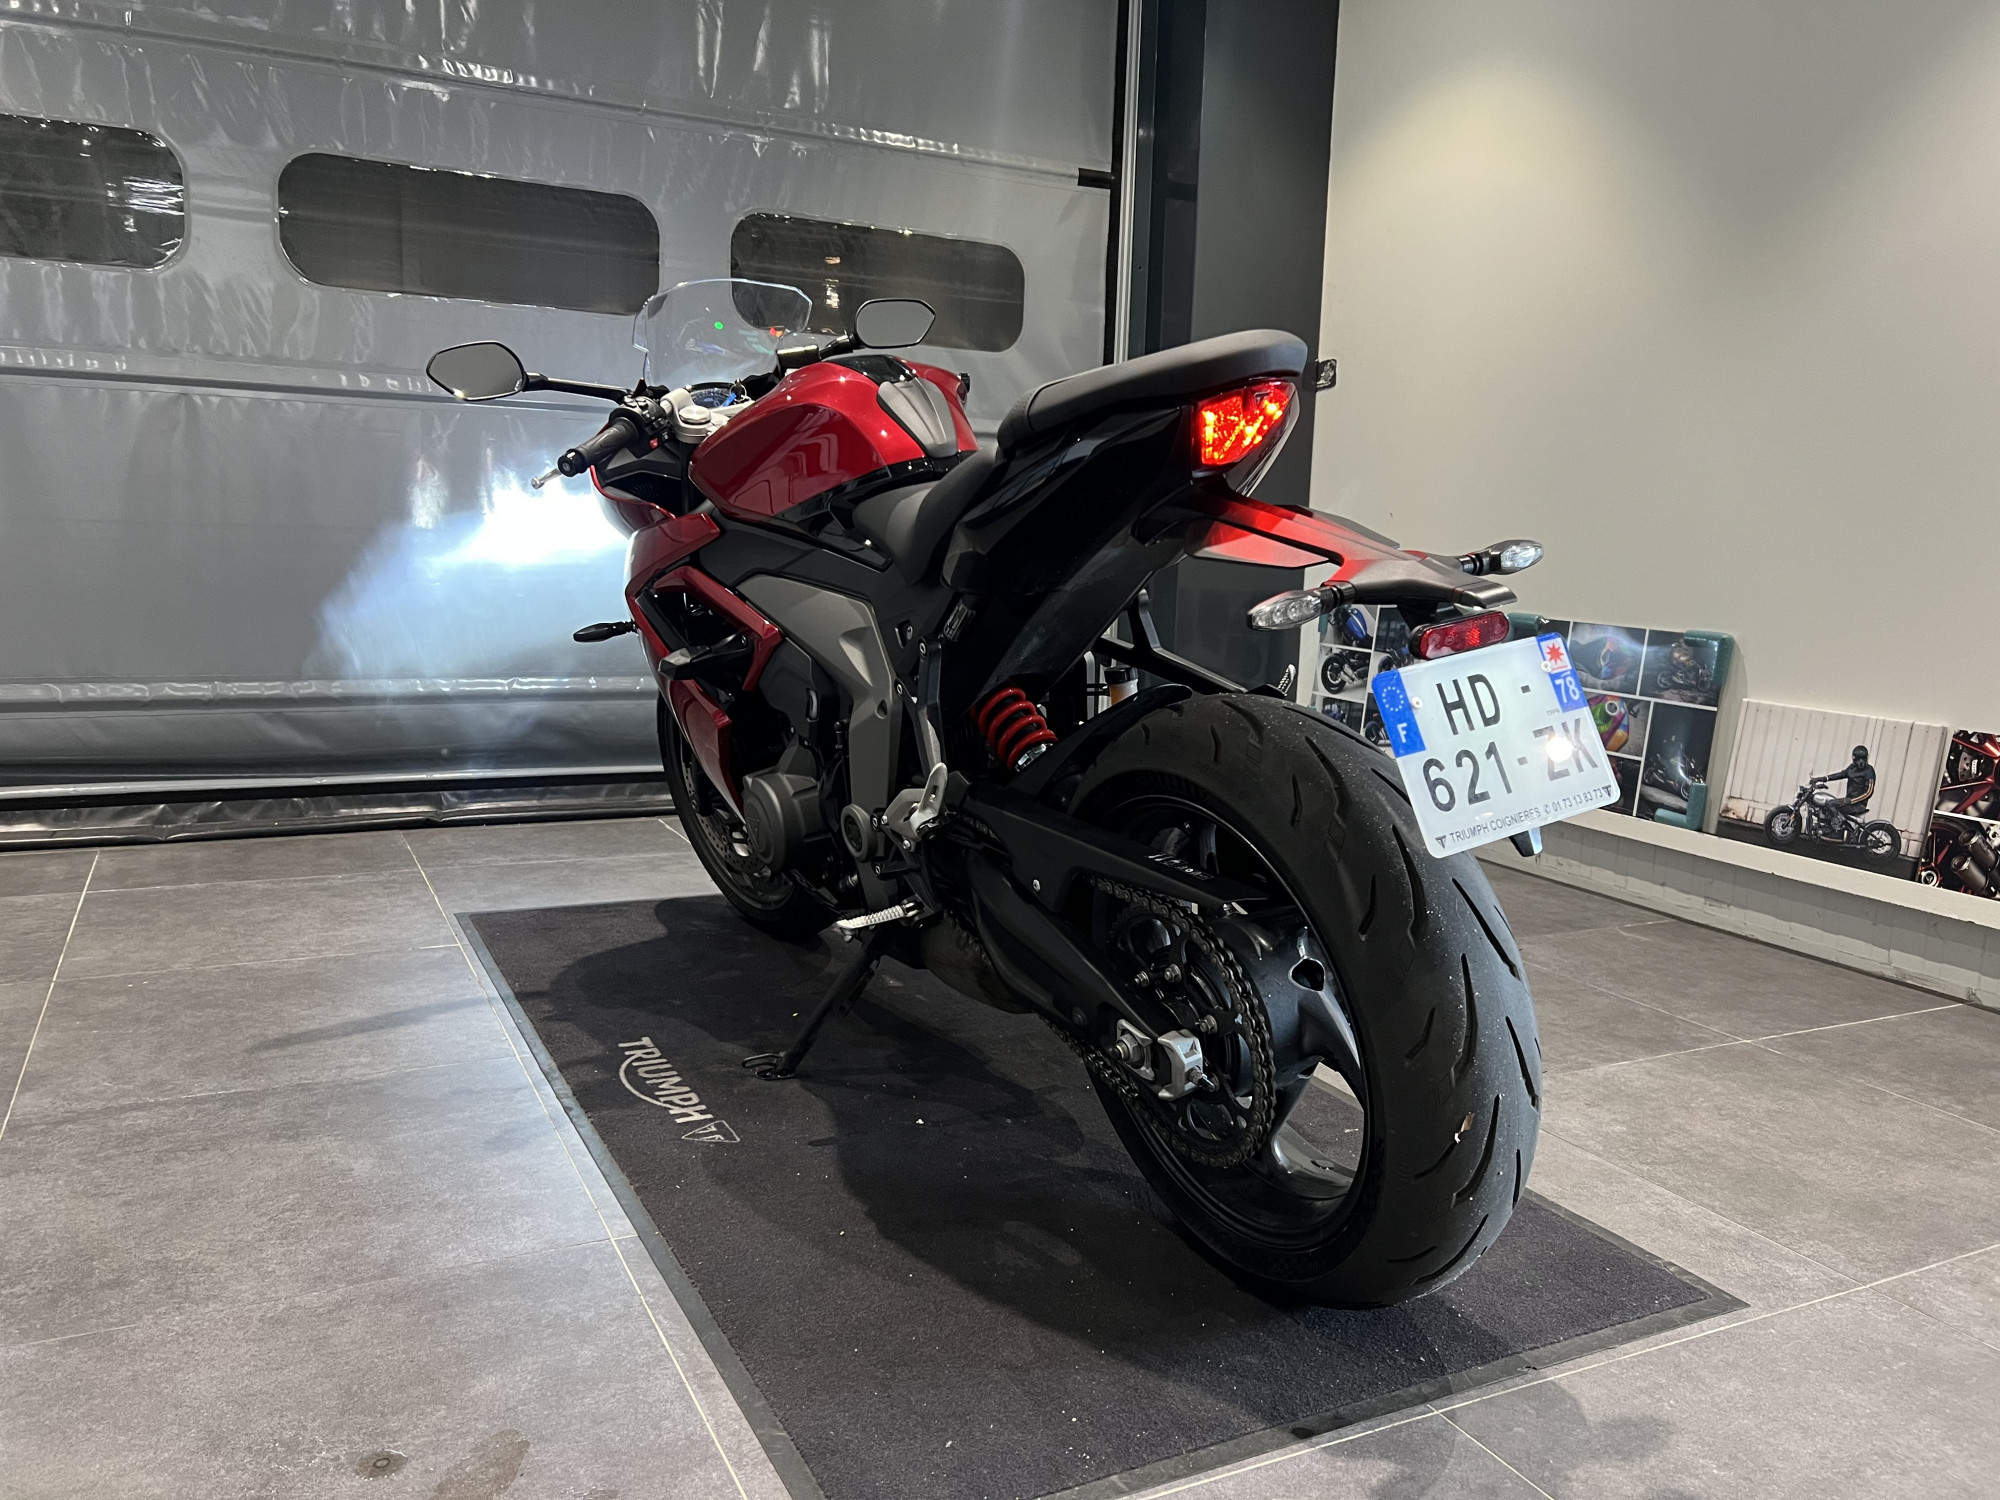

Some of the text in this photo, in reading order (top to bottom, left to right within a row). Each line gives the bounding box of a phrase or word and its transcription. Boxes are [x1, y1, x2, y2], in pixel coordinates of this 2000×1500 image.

[1436, 674, 1500, 735] HD
[1554, 676, 1580, 703] 78
[1396, 722, 1408, 743] F
[1449, 823, 1489, 843] TRIUMPH
[1552, 801, 1562, 812] 01
[1563, 797, 1573, 808] 73
[1573, 794, 1583, 805] 13
[1593, 788, 1603, 800] 73
[618, 1036, 714, 1124] TRIUMPH
